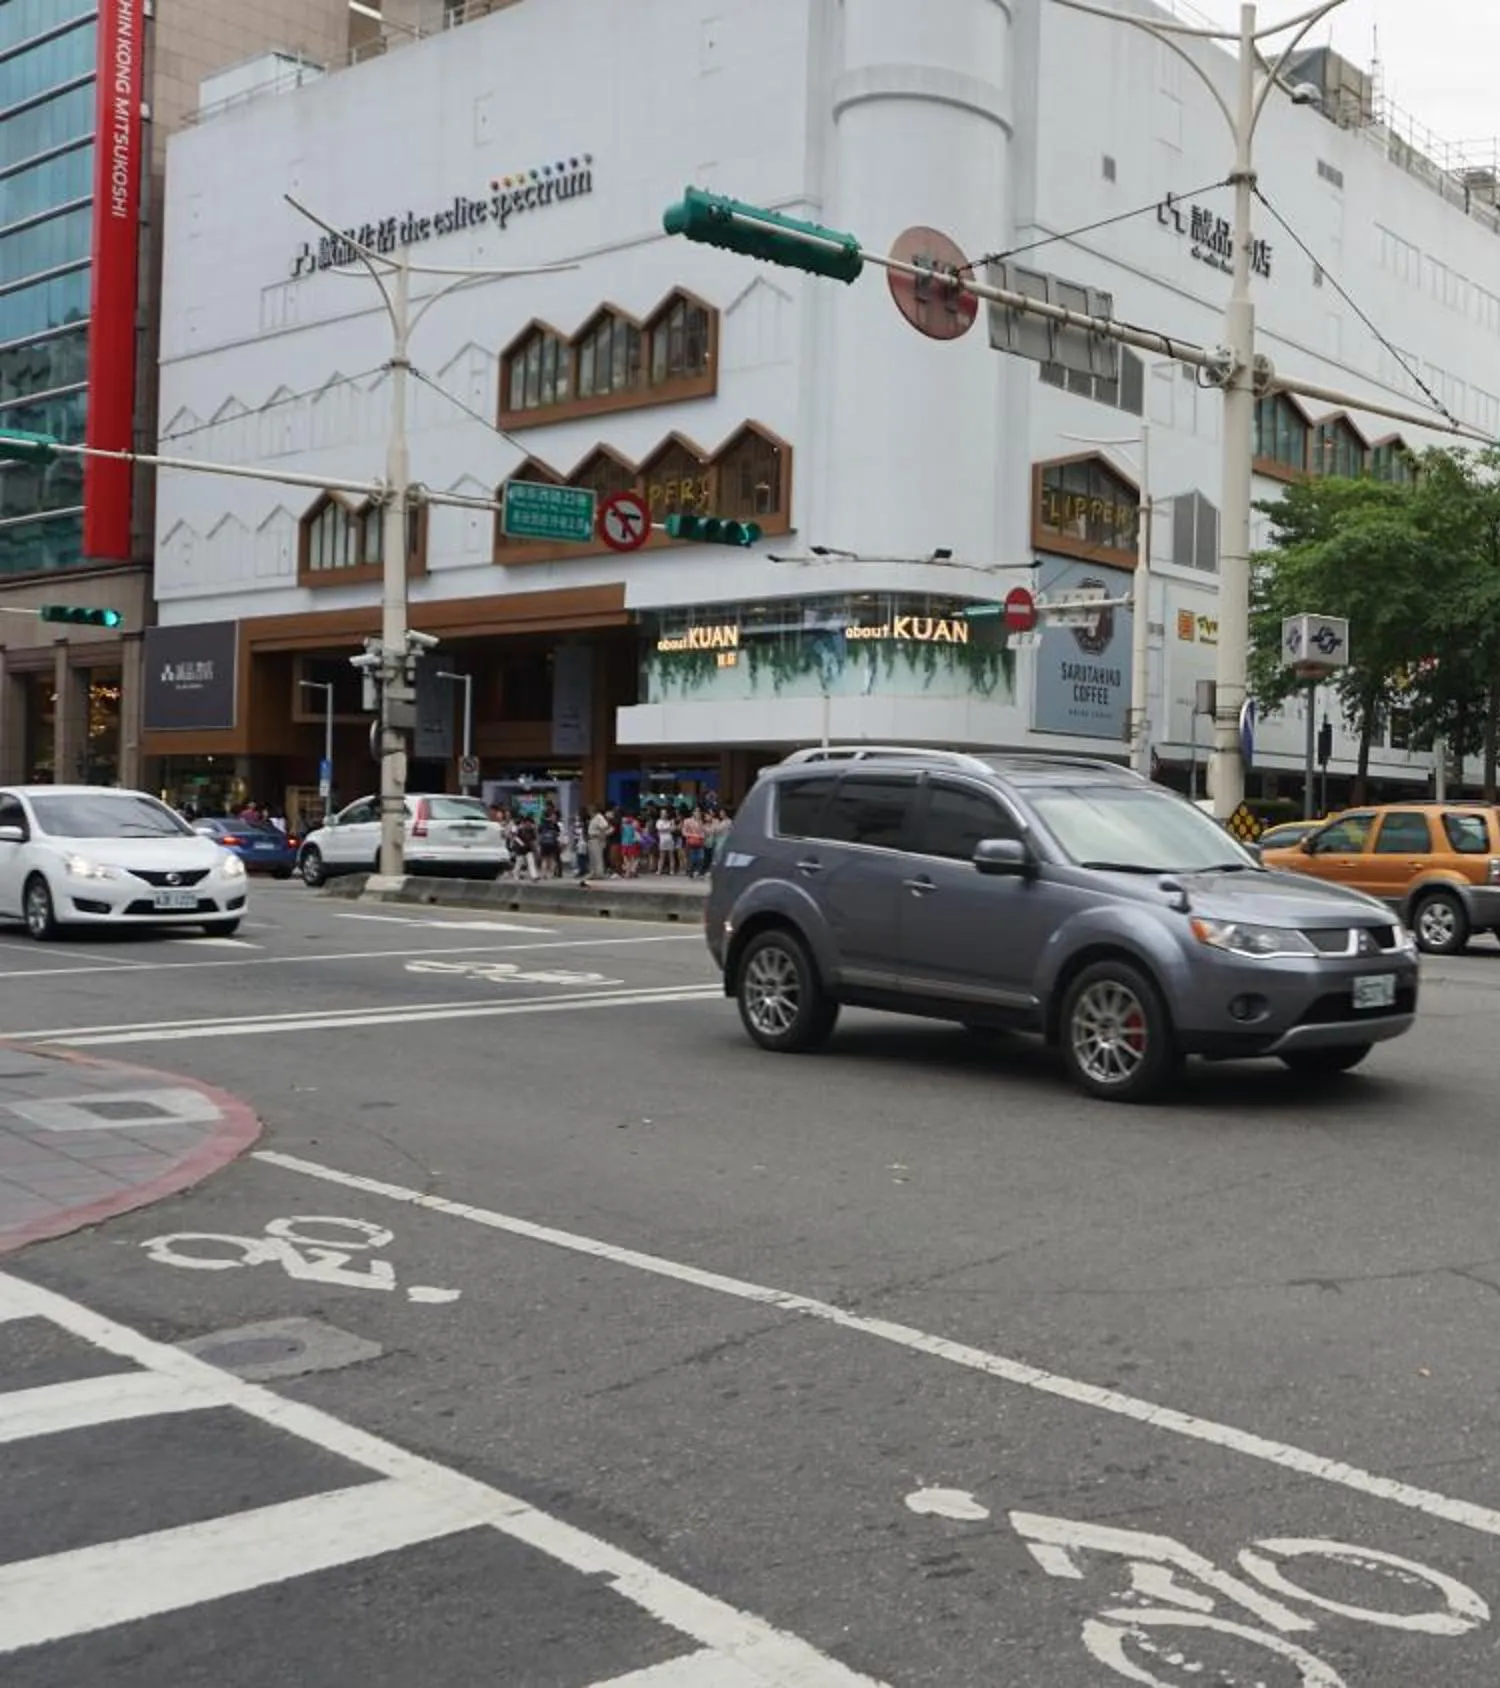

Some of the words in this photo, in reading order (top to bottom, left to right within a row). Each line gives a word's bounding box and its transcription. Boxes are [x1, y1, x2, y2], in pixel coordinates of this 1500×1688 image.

[117, 0, 133, 37] HIN
[115, 38, 132, 94] KONG
[111, 98, 131, 218] MITSUKOSHI
[400, 210, 431, 245] the
[433, 196, 488, 236] eslite
[490, 168, 593, 230] spectrum
[1190, 203, 1274, 278] 誠品店
[657, 637, 687, 651] about
[688, 625, 739, 649] KUAN
[845, 624, 889, 639] about
[893, 615, 969, 643] KUAN
[1073, 684, 1109, 706] COFFEE
